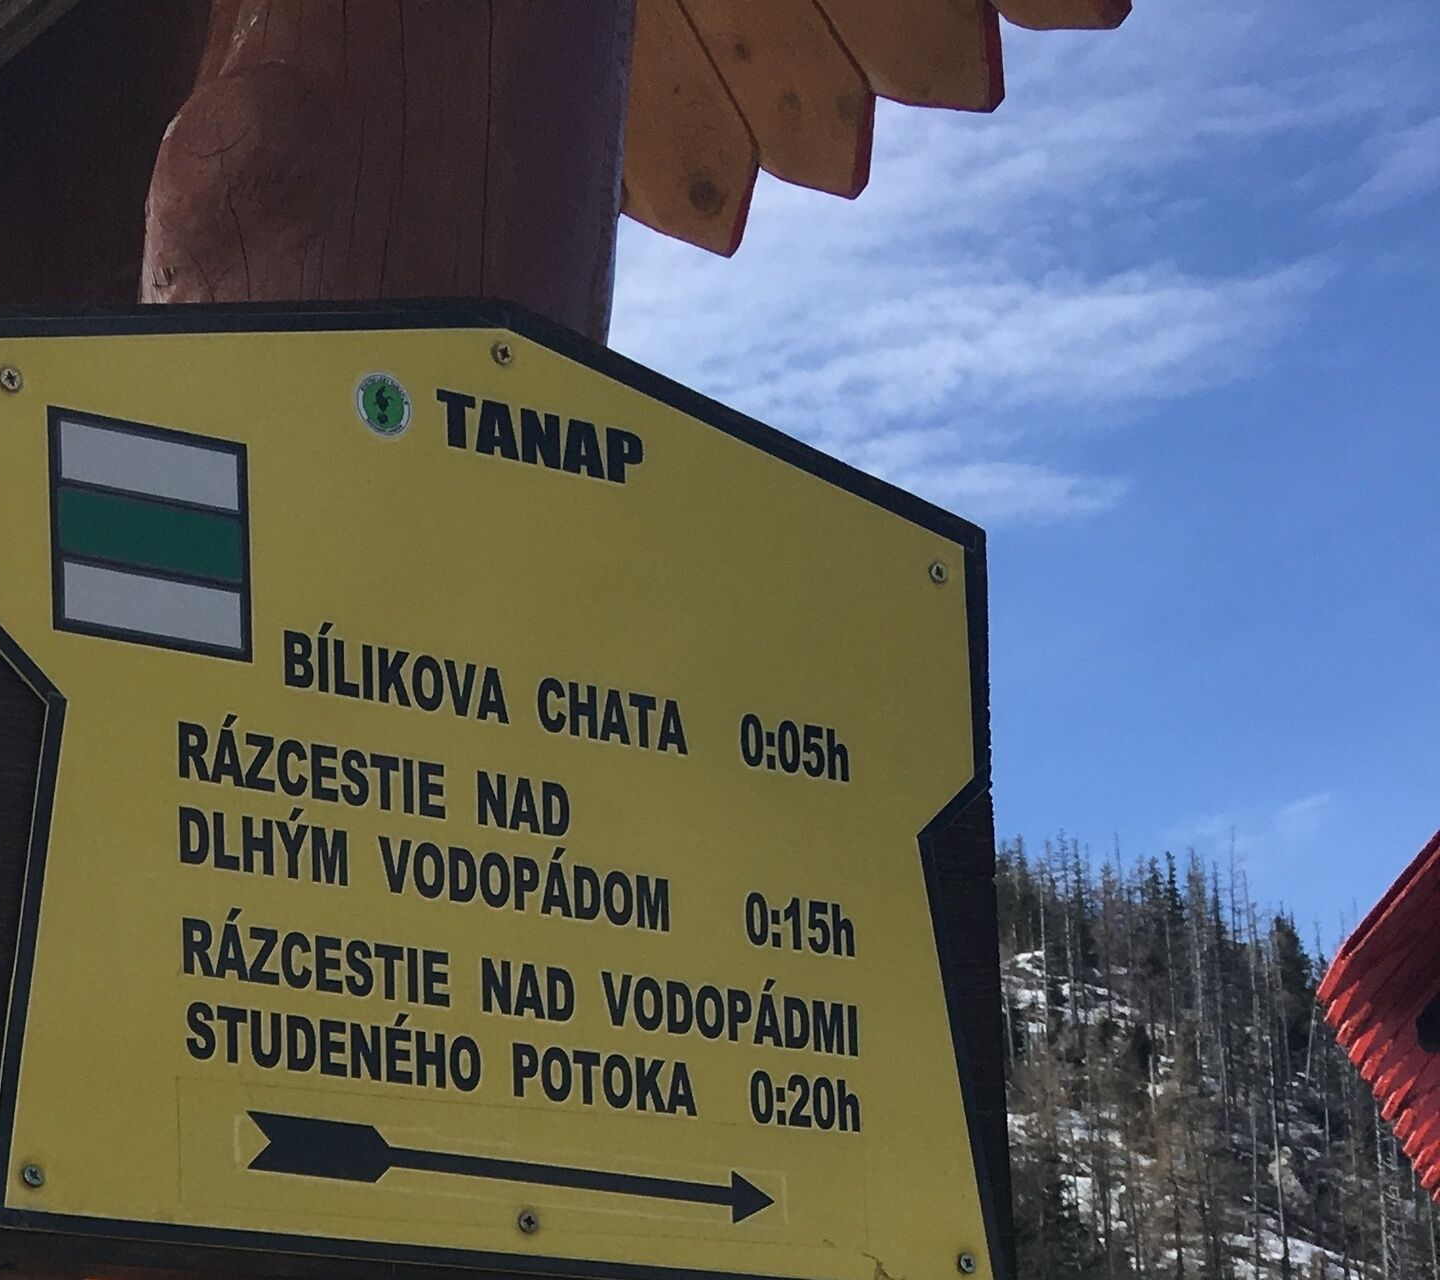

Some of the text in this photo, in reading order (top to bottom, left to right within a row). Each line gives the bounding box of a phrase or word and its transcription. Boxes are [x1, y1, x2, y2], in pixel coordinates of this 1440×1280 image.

[437, 389, 643, 483] TANAP
[284, 622, 849, 782] BÍLIKOVA CHATA 0:05h
[178, 714, 569, 836] RÁZCESTIE NAD
[179, 806, 855, 957] DLHÝM VODOPÁDOM 0:15h
[182, 908, 858, 1056] RÁZCESTIE NAD VODOPÁDMI
[186, 1002, 860, 1132] STUDENÉHO POTOKA 0:20h
